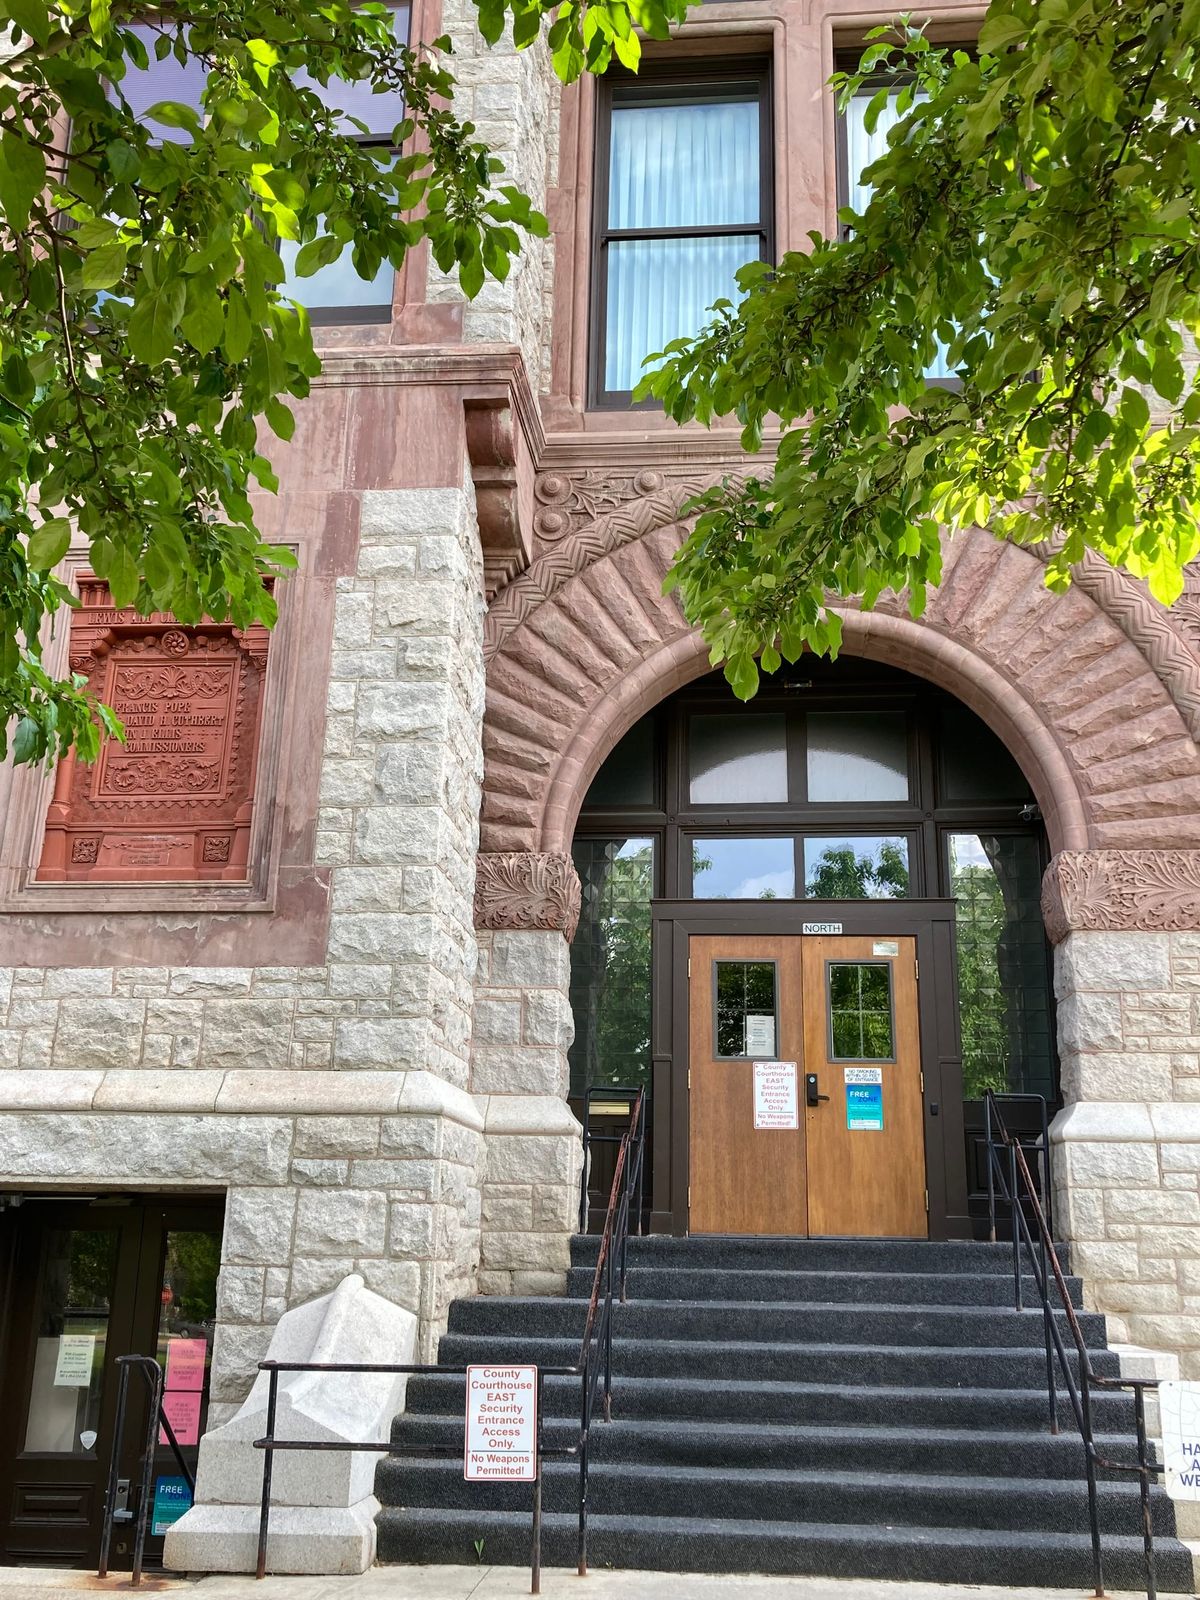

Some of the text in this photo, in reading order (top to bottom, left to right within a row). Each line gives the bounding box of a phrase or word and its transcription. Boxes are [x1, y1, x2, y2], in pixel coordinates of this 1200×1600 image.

[88, 612, 125, 624] LEWIS
[115, 702, 191, 714] FRANCIS POPE
[126, 715, 155, 727] DAVID
[171, 715, 224, 727] CUTHBERT
[151, 729, 182, 740] ELLIS
[124, 742, 206, 754] COMMISSIONERS
[804, 924, 840, 933] NORTH
[850, 1090, 870, 1098] FREE
[483, 1369, 521, 1380] County
[471, 1381, 533, 1390] Courthouse
[487, 1393, 516, 1402] EAST
[480, 1404, 523, 1414] Security
[477, 1416, 525, 1425] Entrance
[482, 1427, 521, 1437] Access
[488, 1439, 515, 1450] Only.
[471, 1454, 530, 1465] No Weapons
[476, 1466, 525, 1475] Permitted!
[159, 1485, 183, 1494] FREE
